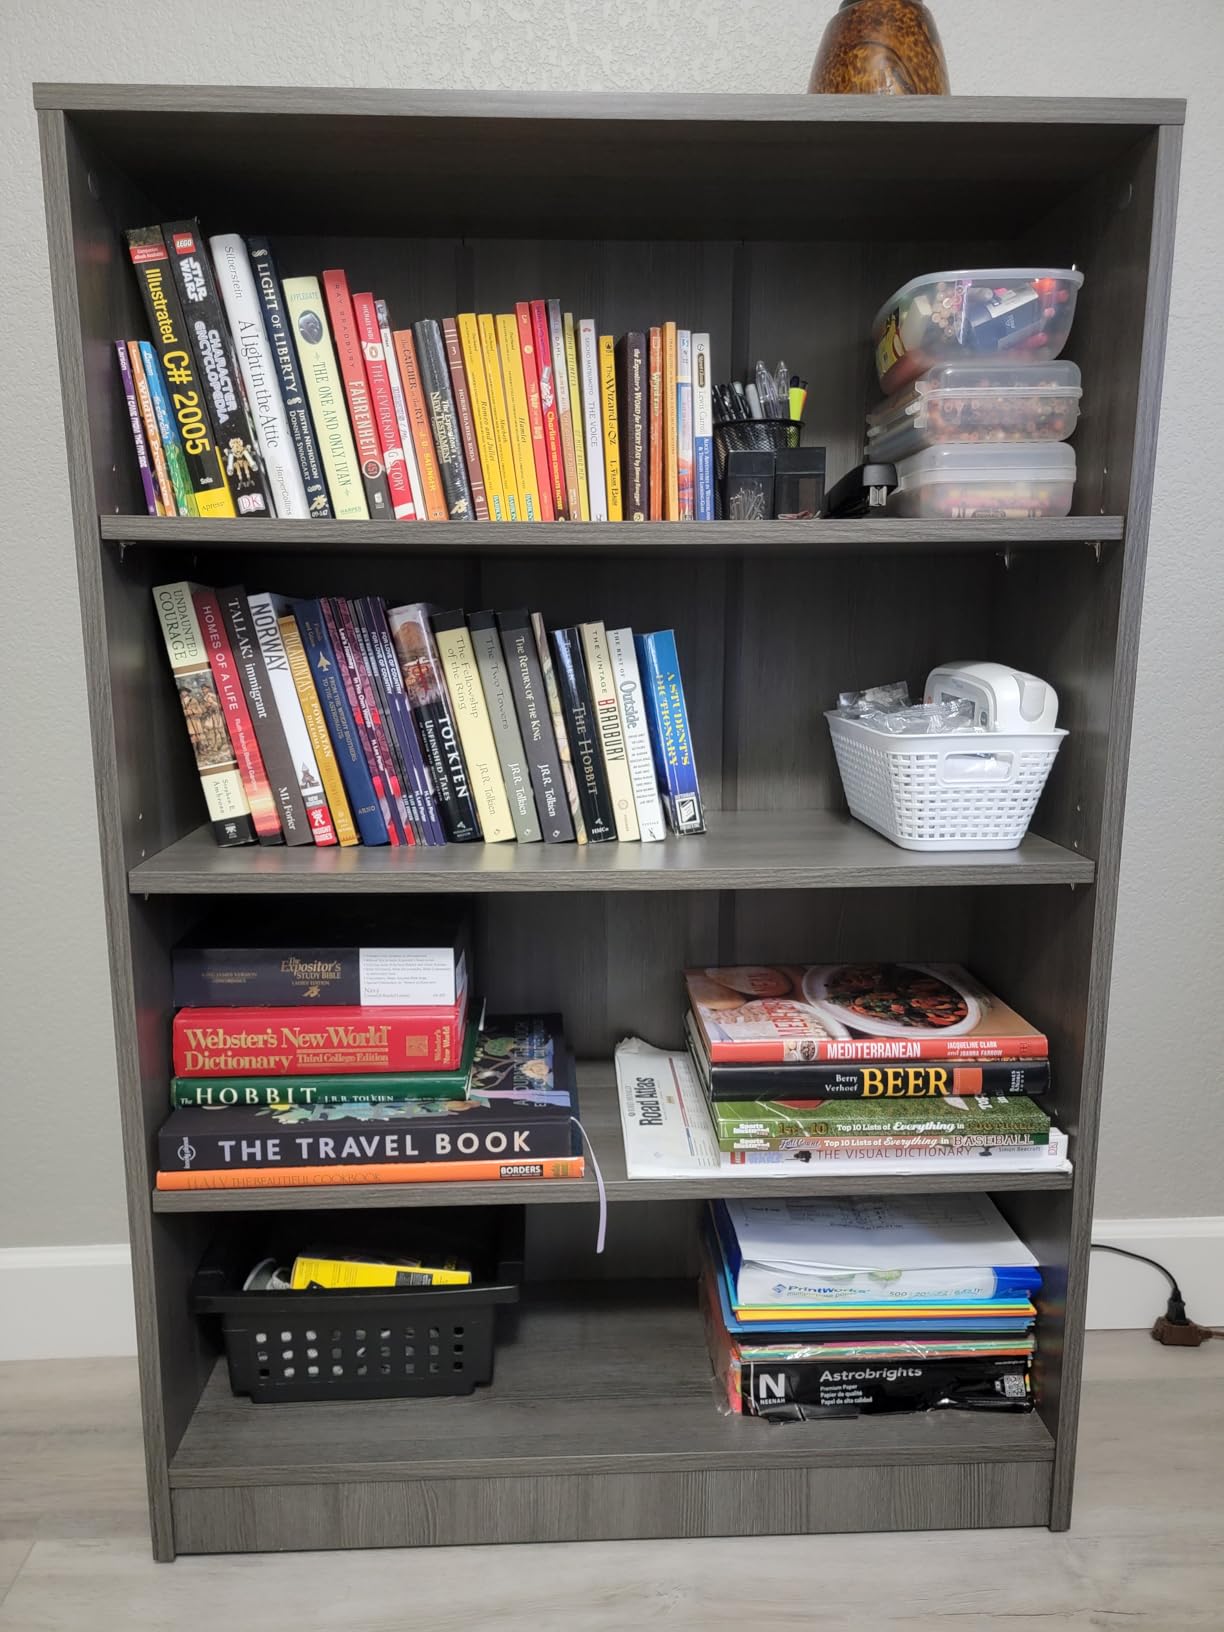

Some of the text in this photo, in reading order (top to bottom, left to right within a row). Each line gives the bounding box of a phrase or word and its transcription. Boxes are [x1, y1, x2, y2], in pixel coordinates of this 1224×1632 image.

[176, 239, 193, 248] LEGO
[178, 258, 199, 302] WARS
[188, 256, 209, 300] STAR
[223, 244, 244, 298] Silverstein
[144, 267, 177, 343] Illustrated
[256, 262, 298, 393] LIGHT OF LIBERTY
[162, 348, 194, 385] C#
[190, 319, 232, 423] ENCYCLOPEDIA
[205, 329, 240, 411] CHARACTER
[238, 318, 282, 448] A Light in the Attic
[371, 364, 384, 384] THE
[348, 380, 378, 457] FAHRENHEIT
[431, 391, 442, 412] NEW
[605, 377, 615, 421] Wizard
[173, 390, 211, 454] 2005
[296, 408, 320, 479] JUSTIN NICHOLSON
[311, 362, 351, 486] THE ONE AND ONLY IVAN
[375, 388, 398, 458] NEVERENDING
[435, 413, 452, 463] TESTAMENT
[546, 411, 556, 439] Charlie
[589, 422, 597, 448] VOICE
[288, 409, 311, 481] DONNIE SWAGGART
[274, 465, 292, 514] HarperCollins
[388, 460, 404, 493] STORY
[239, 496, 261, 512] DK
[159, 591, 186, 659] COURAGE
[173, 590, 197, 656] UNDAUNTED
[249, 602, 288, 674] NORWAY
[612, 631, 620, 644] THE
[202, 605, 221, 648] HOMES
[215, 652, 227, 669] OF
[224, 685, 237, 709] LIFE
[227, 597, 253, 658] TALLAK!
[243, 663, 267, 719] immigrant
[283, 630, 313, 692] POCAHONTAS
[374, 644, 382, 658] LOVE
[381, 667, 392, 694] COUNTRY
[384, 643, 392, 658] LOVE
[390, 667, 402, 694] COUNTRY
[447, 647, 467, 709] of the Ring
[456, 634, 480, 717] The Fellowship
[595, 654, 607, 693] VINTAGE
[485, 636, 509, 729] The Two Towers
[619, 680, 641, 728] Outside
[311, 702, 331, 756] POWHATAN
[598, 698, 623, 761] BRADBURY
[652, 674, 680, 765] DICTIONARY
[424, 720, 443, 773] UNFINISHED
[439, 774, 451, 800] TALES
[436, 714, 470, 797] TOLKIEN
[571, 703, 600, 795] THE HOBBIT
[476, 762, 499, 814] J.R.R. Tolkien
[508, 763, 529, 815] J.R.R. Tolkien
[537, 763, 558, 816] J.R.R. Tolkien
[283, 804, 297, 830] Forier
[281, 960, 342, 976] Expositor's
[297, 971, 342, 980] STUDY BIBLE
[183, 1025, 389, 1050] Webster's New World
[297, 1052, 389, 1064] Third College Edition
[827, 1042, 921, 1059] MEDITERRANEAN
[947, 1040, 998, 1050] JACQUELINE CLARK
[960, 1049, 979, 1057] JOANNA
[184, 1050, 293, 1073] Dictionary
[835, 1074, 858, 1085] Berry
[860, 1067, 951, 1097] BEER
[180, 1087, 394, 1105] The HOBBIT TOLKIEN
[634, 1077, 663, 1126] Road Atlas
[824, 1084, 859, 1093] Verhoef
[218, 1130, 531, 1162] THE TRAVEL BOOK
[823, 1139, 839, 1148] Top
[840, 1139, 850, 1147] 10
[851, 1138, 873, 1146] Lists
[874, 1138, 882, 1146] of
[883, 1137, 938, 1148] Everything
[953, 1135, 1034, 1147] BASEBALL
[836, 1121, 964, 1133] Top 10 Lists of Everything in
[500, 1166, 541, 1175] BORDERS
[817, 1147, 972, 1160] THE VISUAL DICTIONARY
[232, 1172, 382, 1186] THE BEAUTIFUL COOKBOOK
[788, 1284, 867, 1294] PrintWorks
[759, 1373, 786, 1398] N
[820, 1367, 922, 1382] Astrobrights
[820, 1391, 837, 1399] Papier
[845, 1390, 863, 1398] qualité
[821, 1398, 836, 1406] Papel
[854, 1396, 873, 1404] calidad
